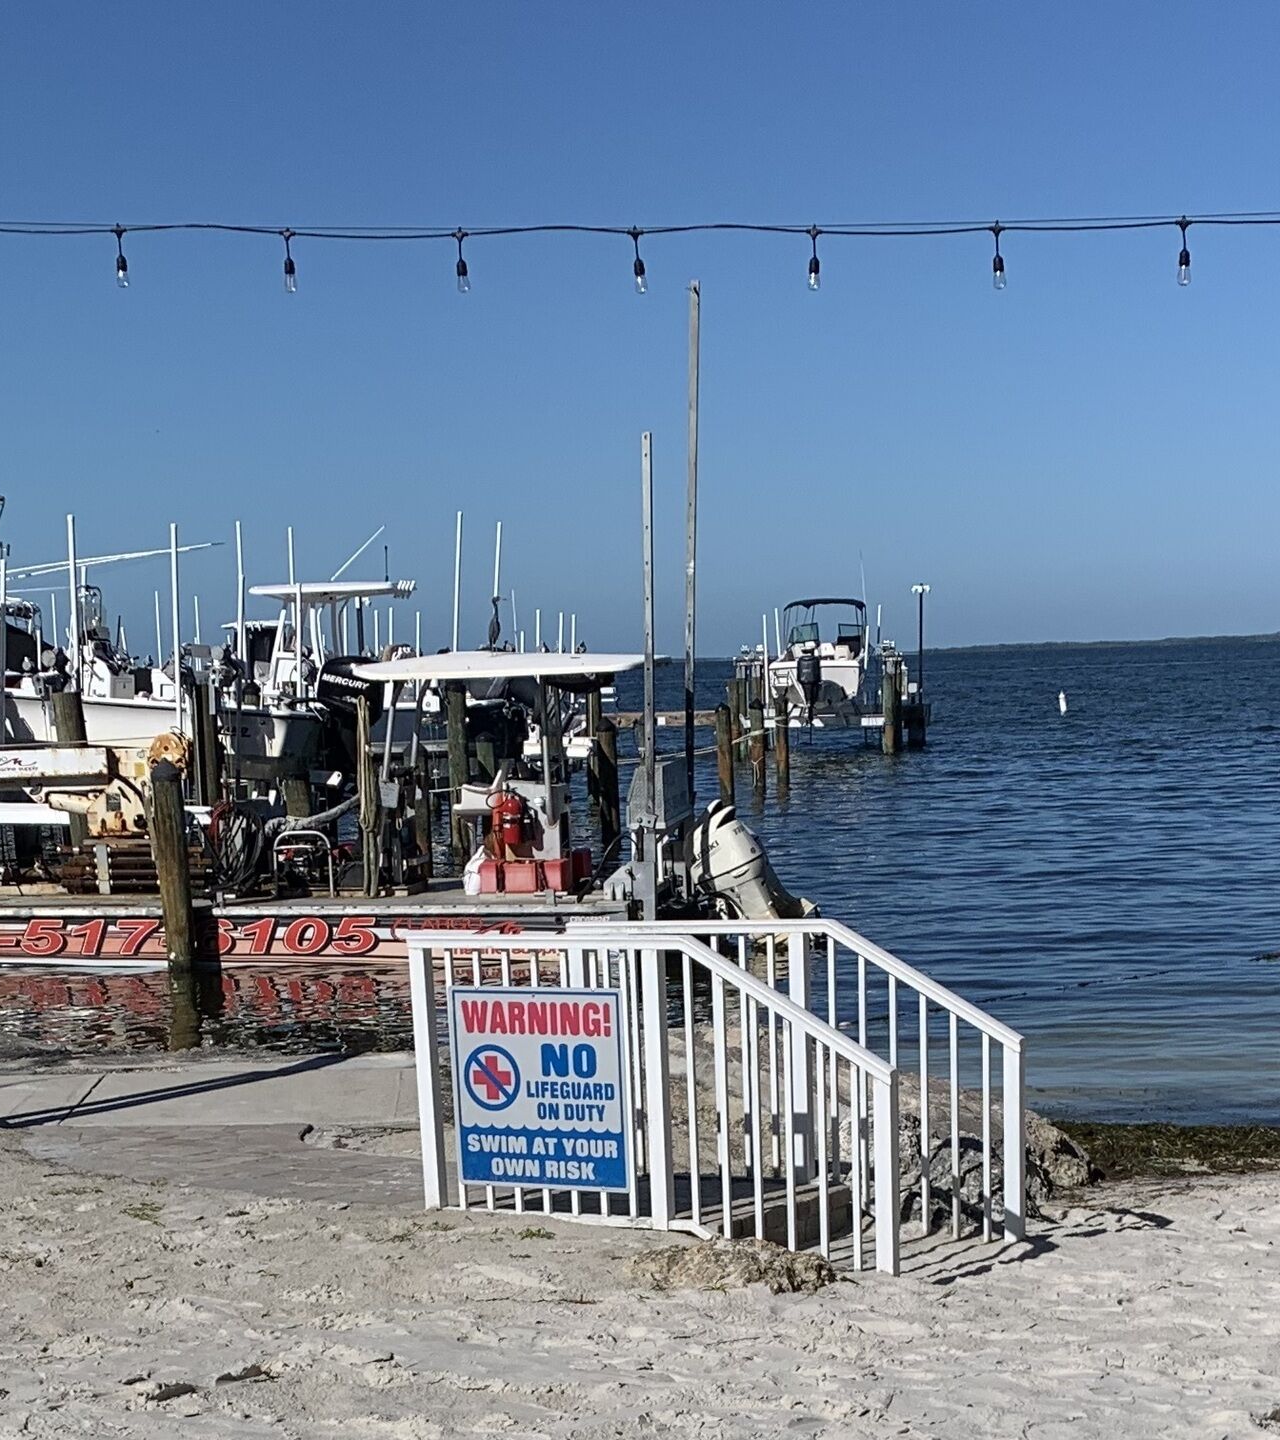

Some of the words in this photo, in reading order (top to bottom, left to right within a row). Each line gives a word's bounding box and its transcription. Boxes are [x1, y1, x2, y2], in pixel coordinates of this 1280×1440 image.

[322, 672, 370, 690] MERCURY
[461, 1000, 612, 1038] WARNING!
[540, 1043, 597, 1078] NO
[526, 1080, 615, 1101] LIFEGUARD
[537, 1102, 560, 1120] ON
[564, 1104, 606, 1122] DUTY
[467, 1134, 527, 1154] SWIM
[532, 1137, 559, 1156] AT
[562, 1138, 618, 1159] YOUR
[491, 1157, 541, 1178] OWN
[544, 1160, 596, 1181] RISK
